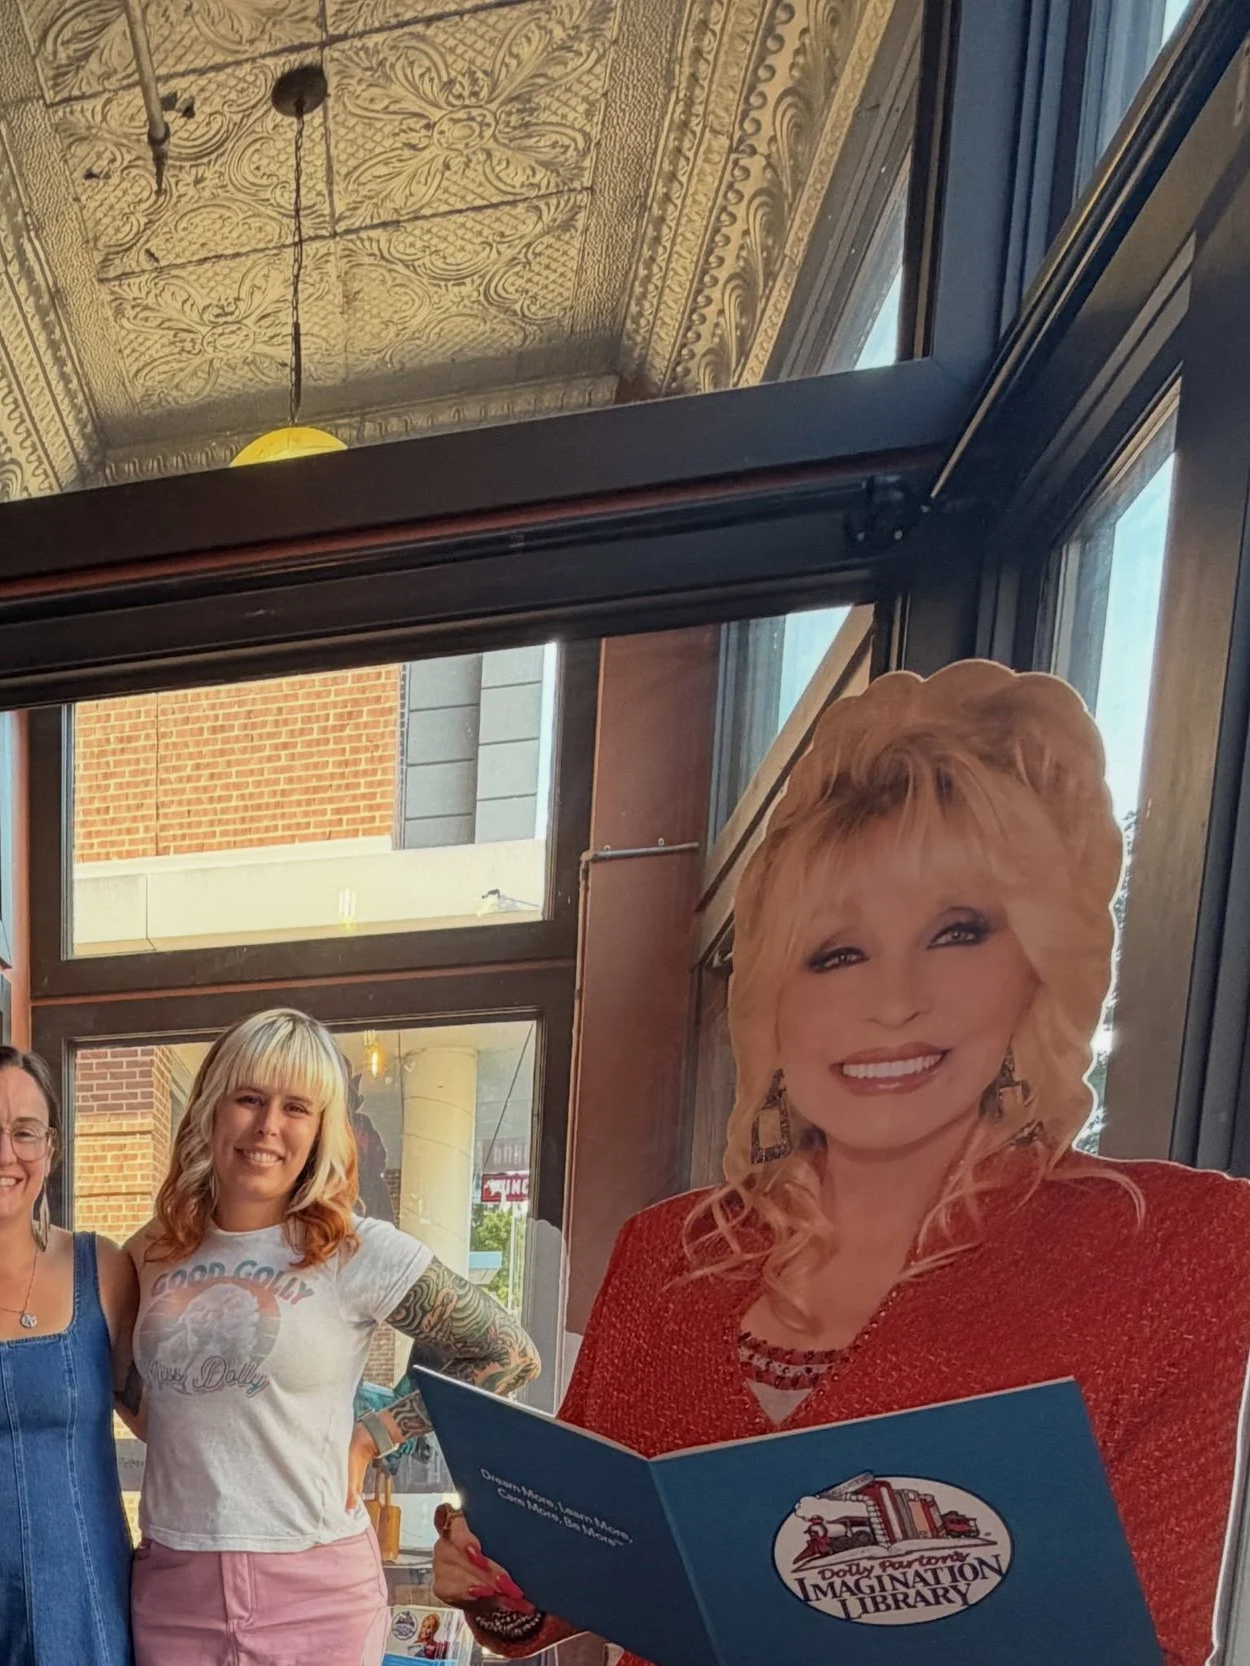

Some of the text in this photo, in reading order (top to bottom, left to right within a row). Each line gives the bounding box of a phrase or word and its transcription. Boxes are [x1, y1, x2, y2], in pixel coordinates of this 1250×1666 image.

[150, 1259, 316, 1306] GOOD GOLLY
[192, 1355, 270, 1398] Dolly
[480, 1467, 634, 1545] Dream More, Learn More,
[497, 1487, 526, 1508] Care
[526, 1499, 563, 1524] More,
[563, 1515, 581, 1532] Be
[793, 1554, 1006, 1602] IMAGINATION
[817, 1549, 971, 1581] Dolly Parton's
[838, 1582, 972, 1620] LIBRARY
